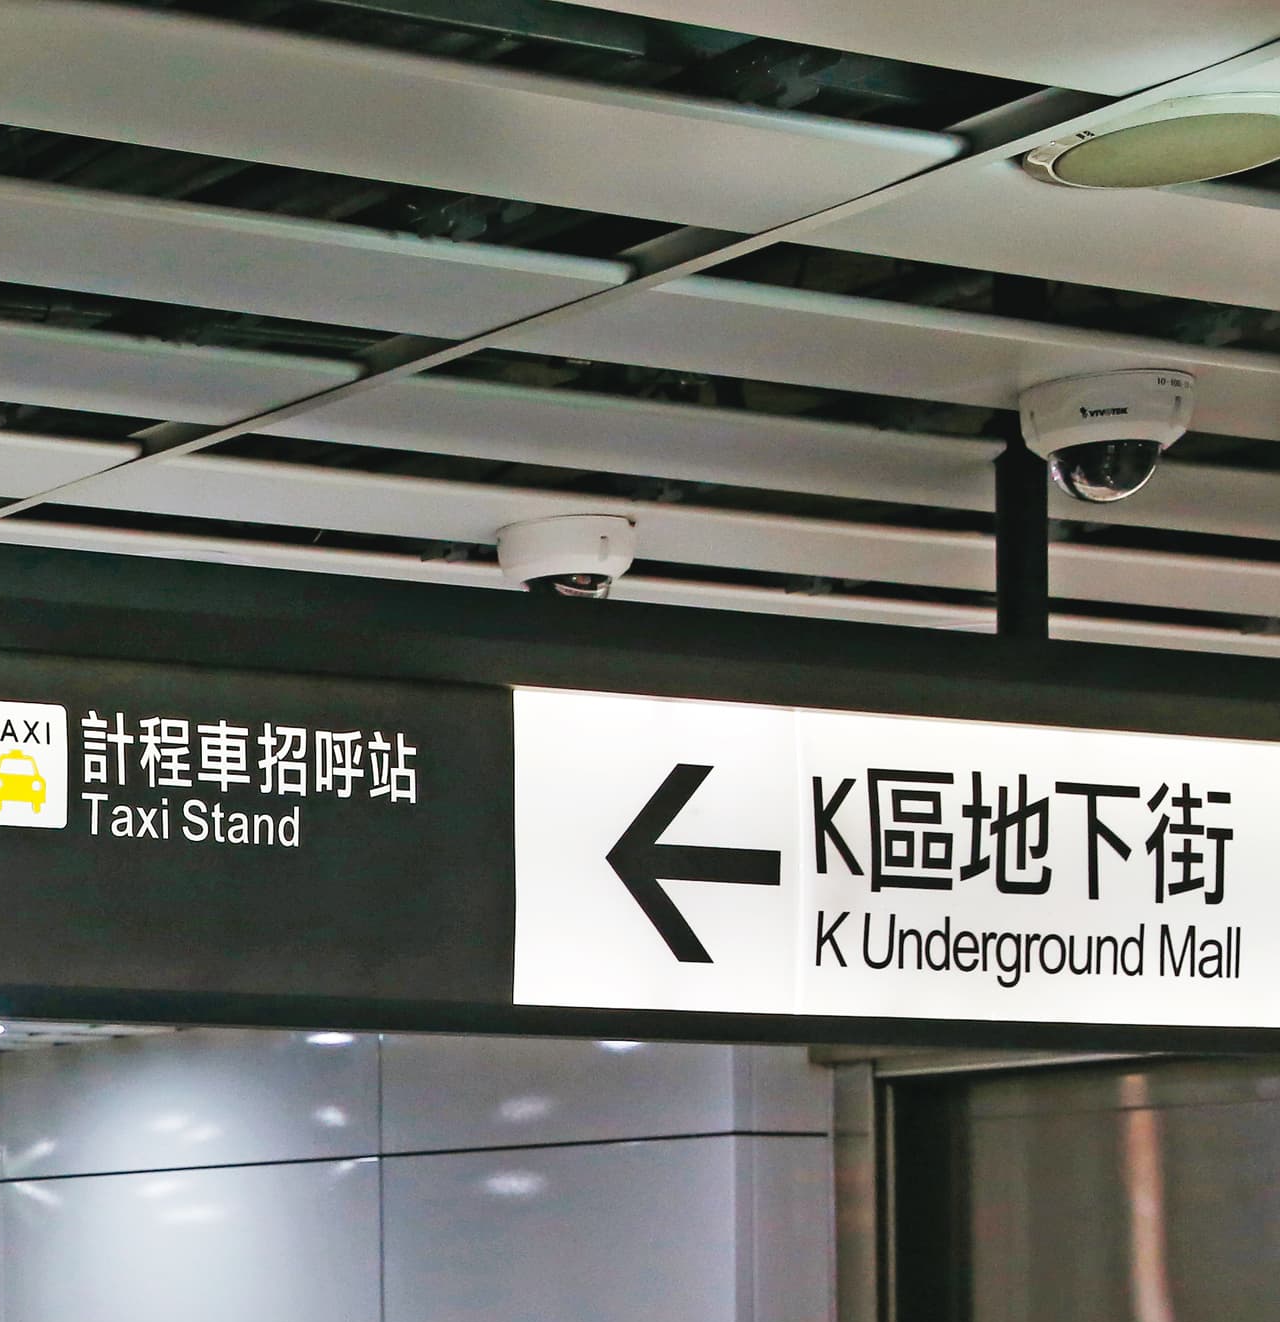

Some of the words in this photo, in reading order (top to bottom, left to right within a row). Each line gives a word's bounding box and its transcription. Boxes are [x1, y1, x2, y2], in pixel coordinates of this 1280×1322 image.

[81, 710, 417, 804] 計程車招呼站
[81, 792, 169, 840] Taxi
[182, 799, 300, 847] Stand
[812, 767, 1234, 905] K區地下街
[815, 910, 851, 968] K
[862, 912, 1145, 989] Underground
[1159, 923, 1241, 979] Mall
